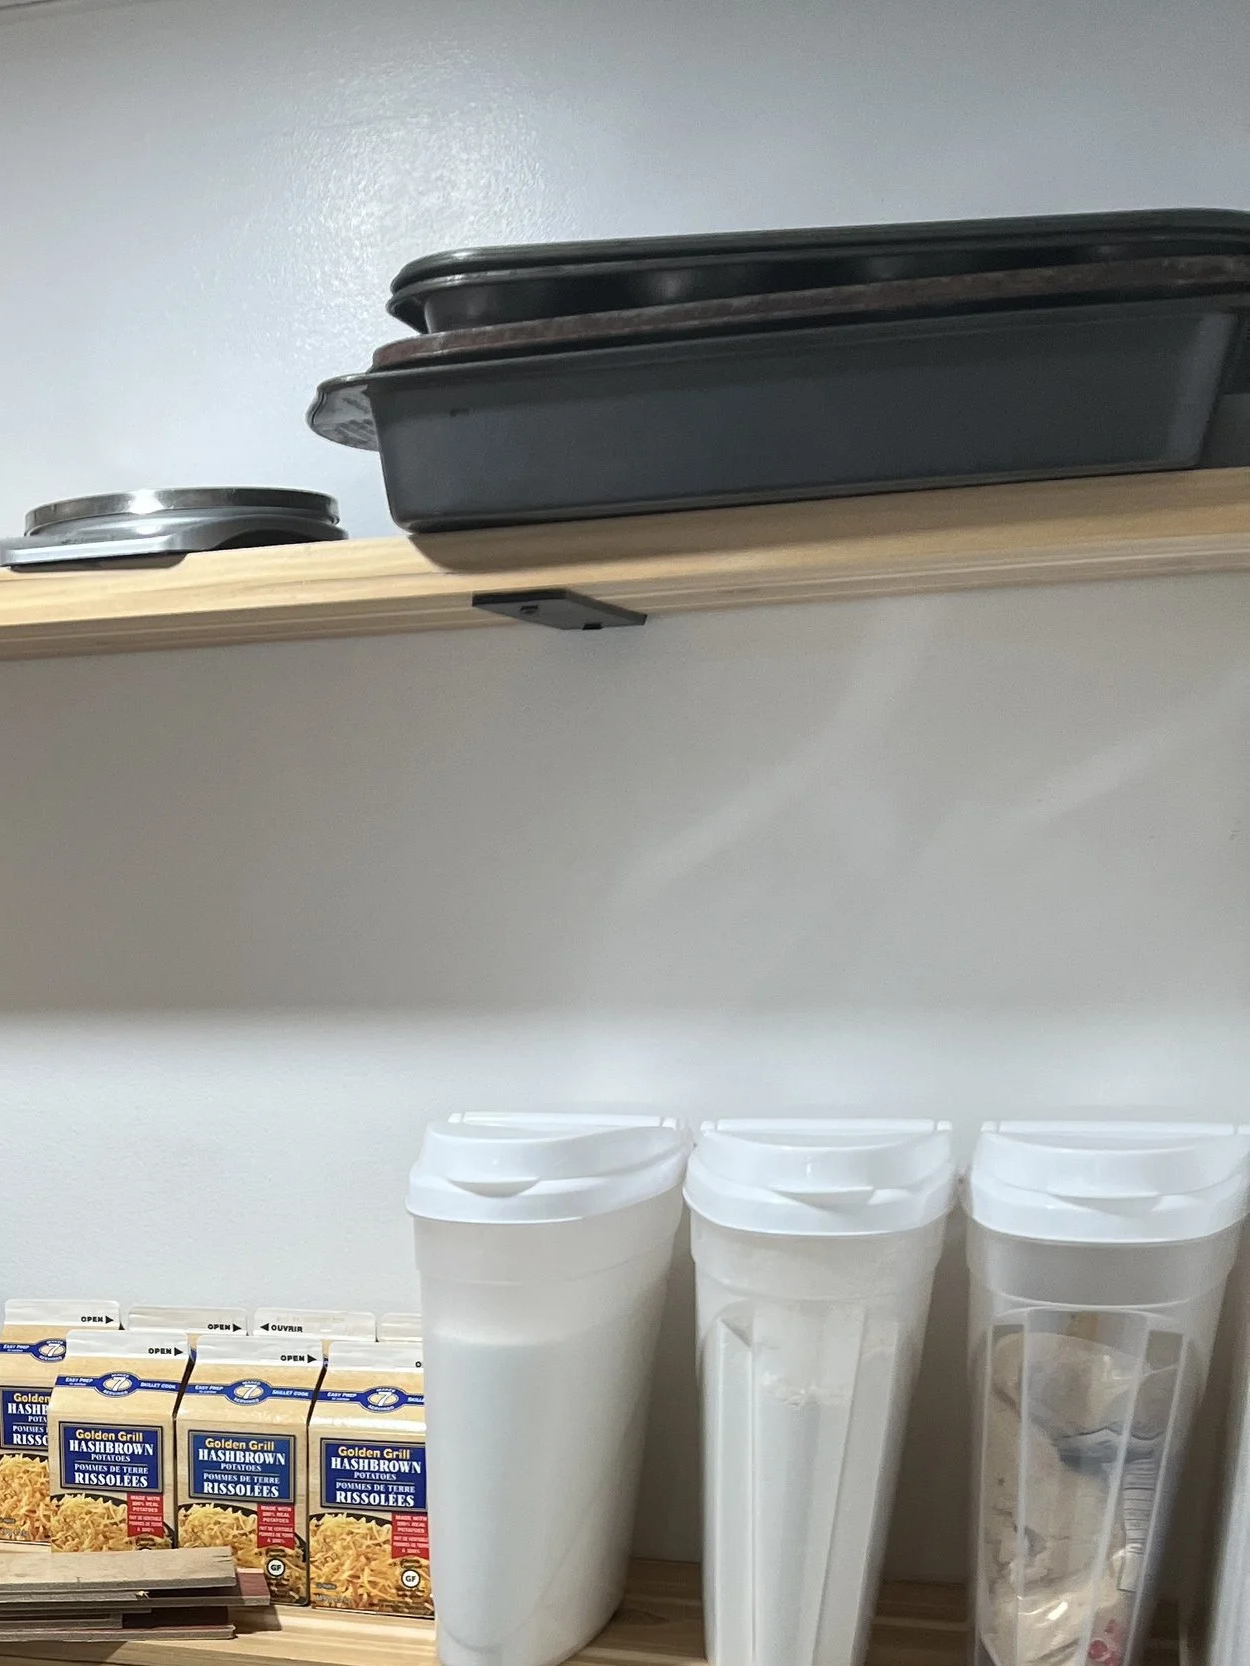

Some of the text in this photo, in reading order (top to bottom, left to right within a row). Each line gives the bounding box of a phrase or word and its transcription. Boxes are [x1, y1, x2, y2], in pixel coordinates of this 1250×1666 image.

[271, 1324, 303, 1333] OUVRIR
[47, 1343, 61, 1357] 7
[280, 1354, 305, 1362] OPEN
[112, 1376, 126, 1391] 7
[244, 1384, 257, 1399] 7
[377, 1391, 392, 1407] 7
[75, 1429, 143, 1442] Golden Grill
[69, 1440, 154, 1456] HASHBROWN
[205, 1438, 275, 1451] Golden Grill
[91, 1453, 131, 1462] POTATOES
[198, 1449, 286, 1465] HASHBROWN
[338, 1446, 411, 1459] Golden Grill
[74, 1463, 148, 1475] POMMES DE TERRE
[220, 1463, 262, 1472] POTATOES
[330, 1457, 421, 1474] HASHBROWN
[74, 1472, 148, 1488] RISSOLÉES
[203, 1473, 280, 1485] POMMES DE TERRE
[353, 1471, 397, 1481] POTATOES
[203, 1481, 279, 1498] RISSOLÉES
[335, 1481, 416, 1493] POMMES DE TERRE
[335, 1490, 415, 1507] RISSOLÉES
[270, 1564, 282, 1572] GF
[405, 1575, 417, 1583] GF
